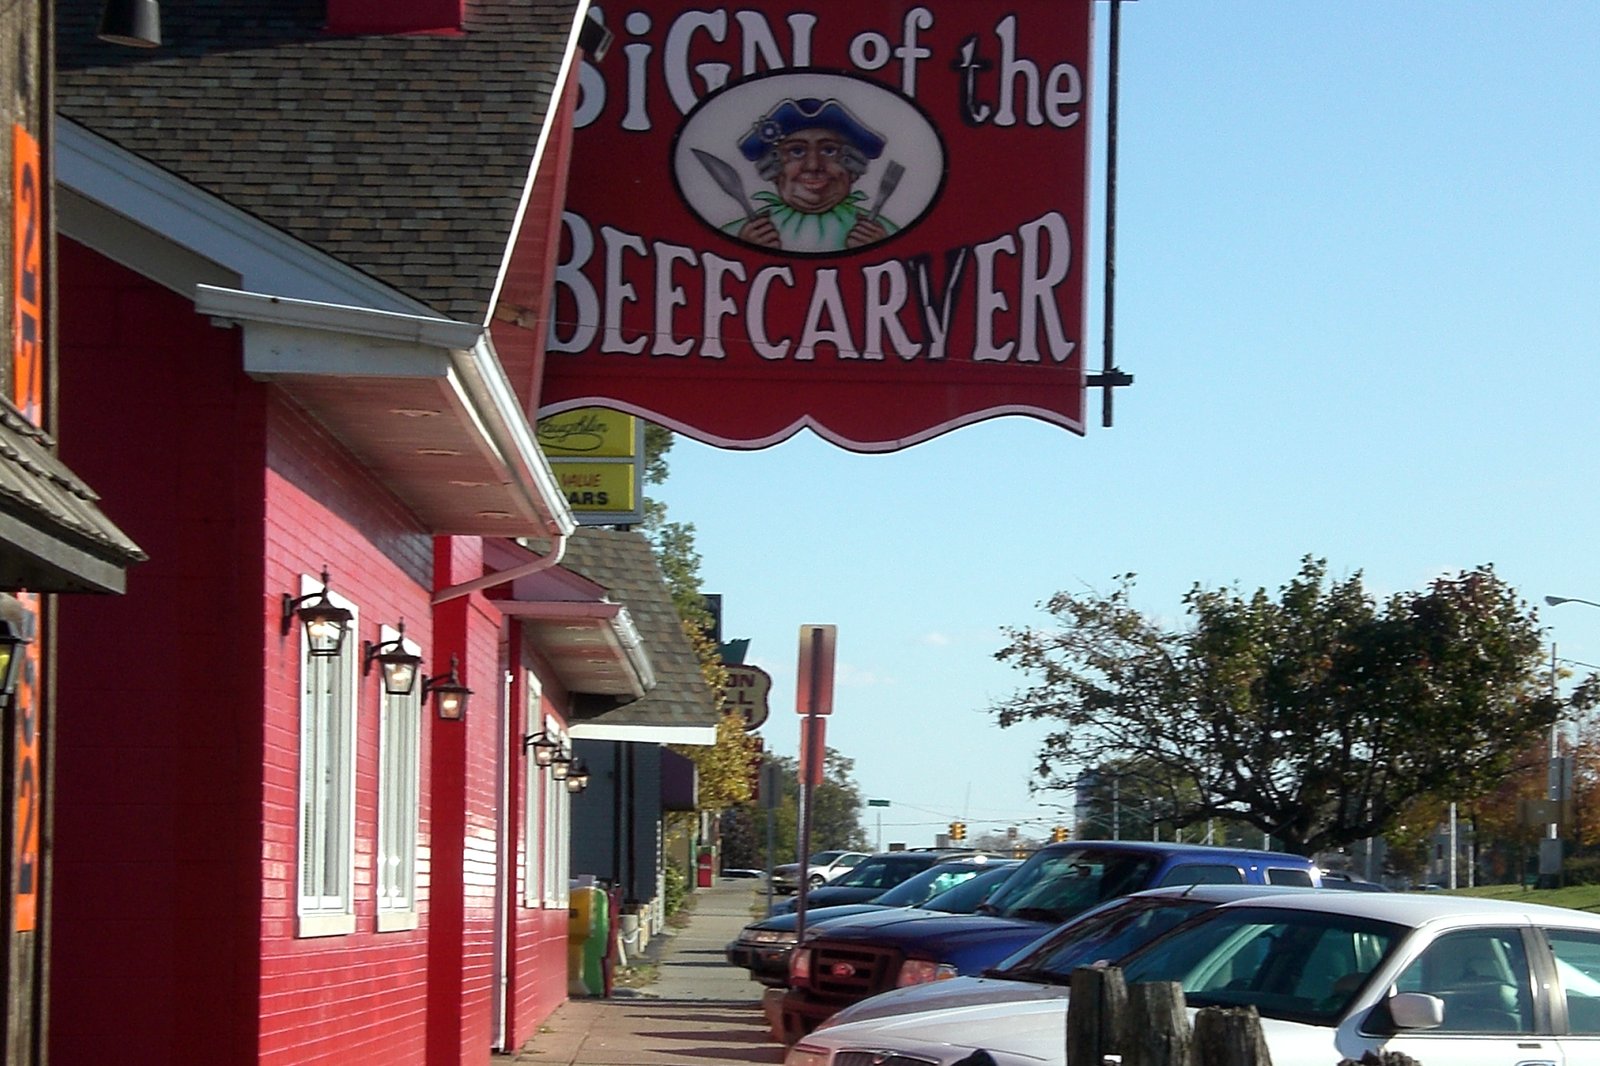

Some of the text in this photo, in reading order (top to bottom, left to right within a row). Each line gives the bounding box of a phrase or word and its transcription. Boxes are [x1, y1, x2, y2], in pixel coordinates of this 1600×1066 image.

[849, 6, 934, 98] of
[958, 14, 1083, 128] the
[545, 211, 1076, 363] BEEFCARVER
[564, 491, 608, 505] ARS
